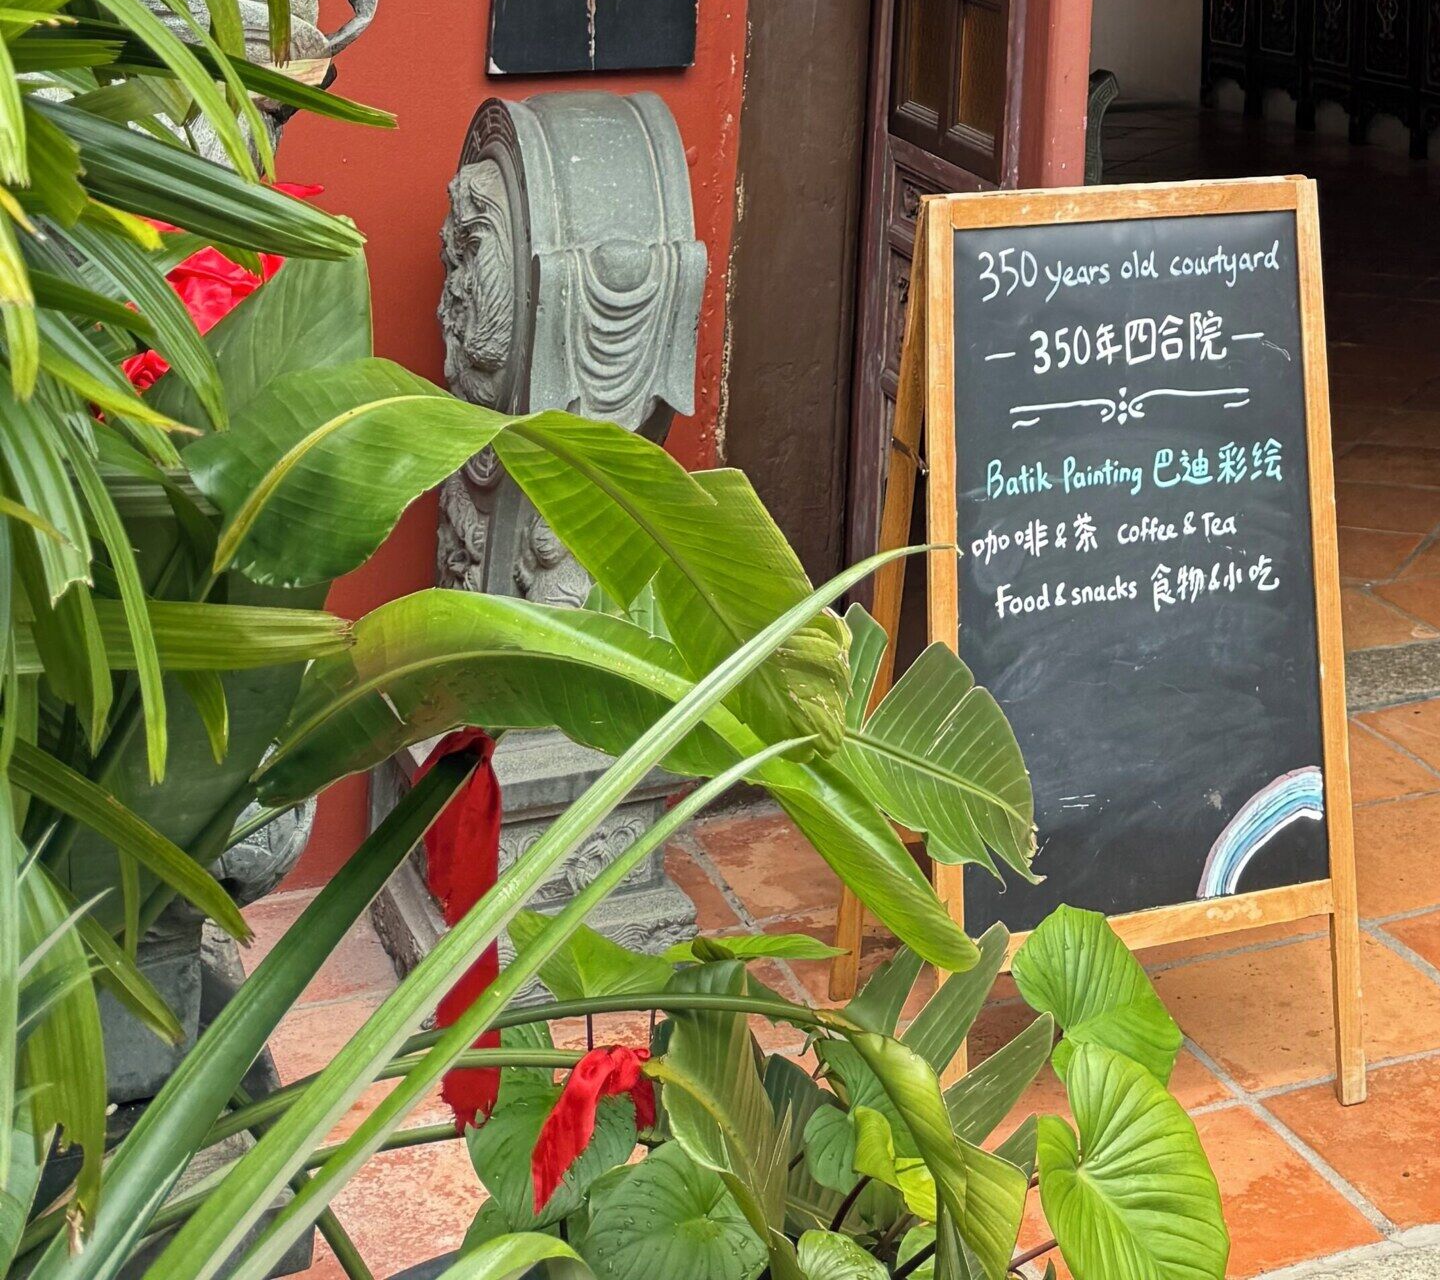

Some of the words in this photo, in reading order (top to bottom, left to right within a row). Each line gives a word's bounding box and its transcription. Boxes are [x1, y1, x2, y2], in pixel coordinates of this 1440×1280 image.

[978, 247, 1038, 302] 350
[1044, 260, 1111, 302] years
[1120, 250, 1159, 279] old
[1169, 239, 1280, 288] courtyard
[986, 459, 1053, 500] Batik
[1063, 456, 1143, 496] Painting
[1153, 437, 1284, 488] 巴迪彩绘
[1201, 511, 1237, 537] Tea
[994, 583, 1051, 619] Food
[1071, 575, 1138, 606] snacks
